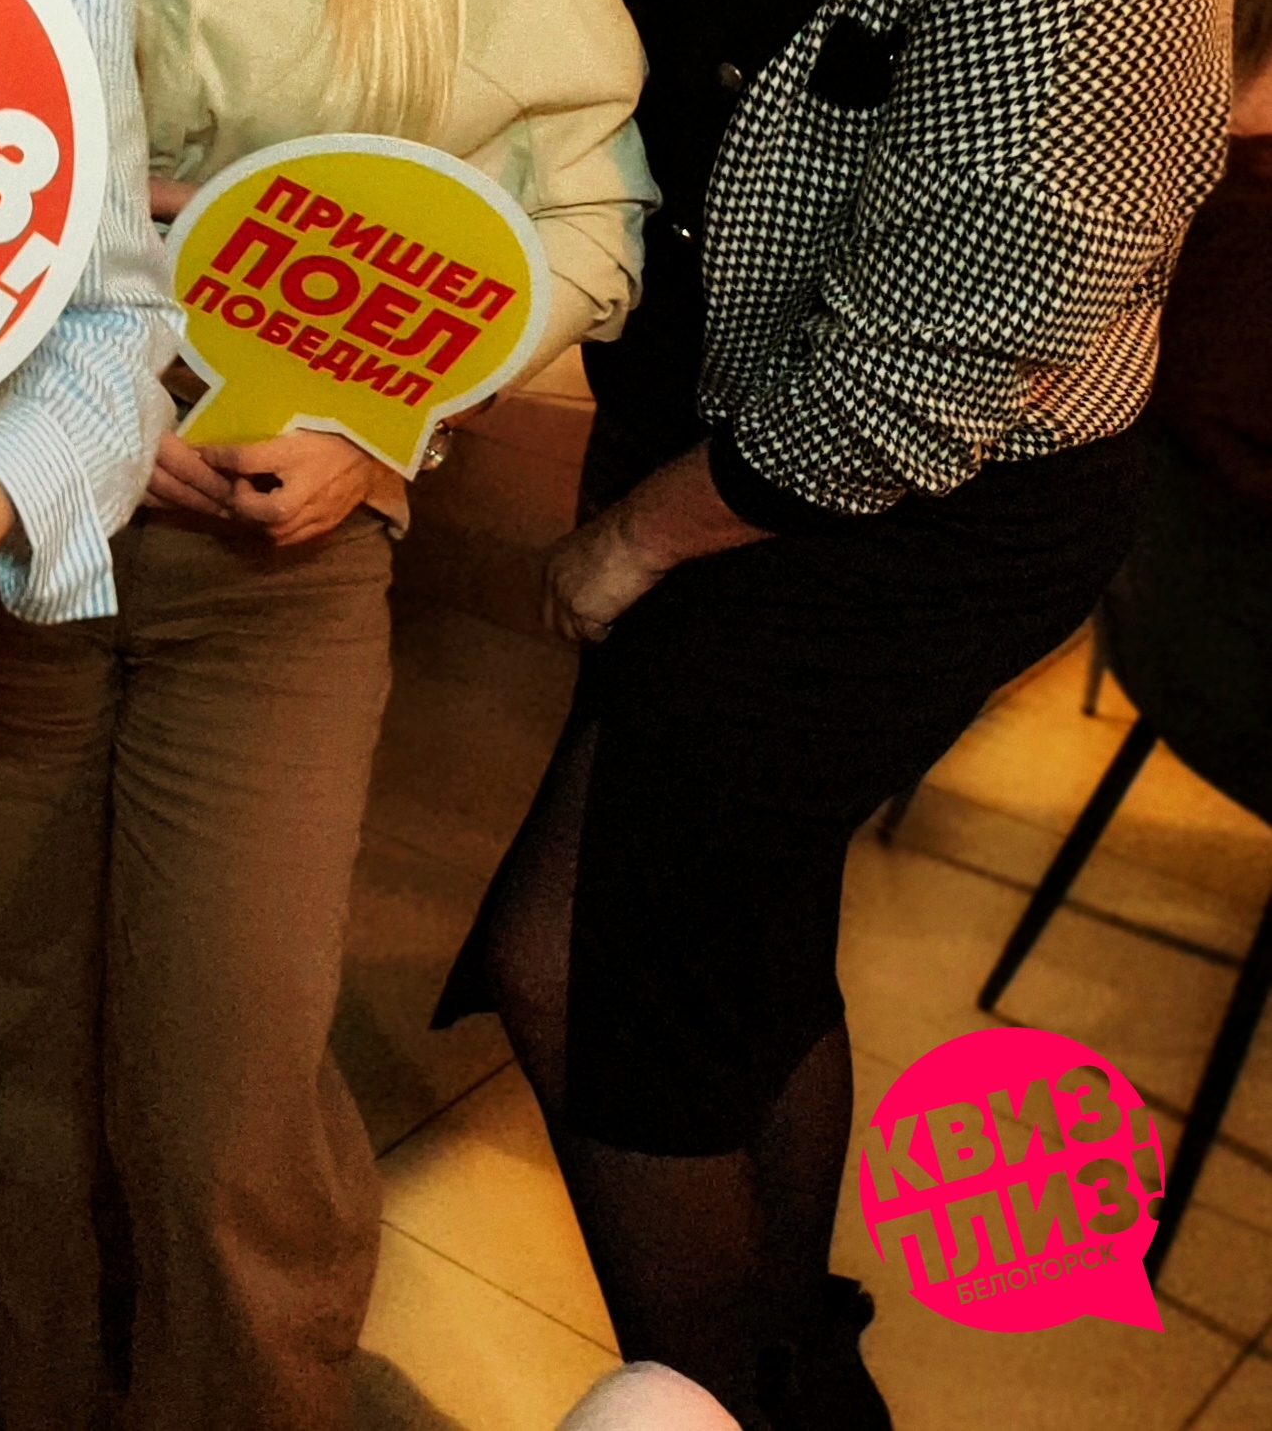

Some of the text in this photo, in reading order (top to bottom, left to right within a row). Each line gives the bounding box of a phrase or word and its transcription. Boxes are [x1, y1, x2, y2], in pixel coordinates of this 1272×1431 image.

[210, 216, 482, 376] ПОЕЛ
[255, 174, 516, 322] ПРИШЕЛ
[183, 274, 434, 407] ПОБЕДИЛ
